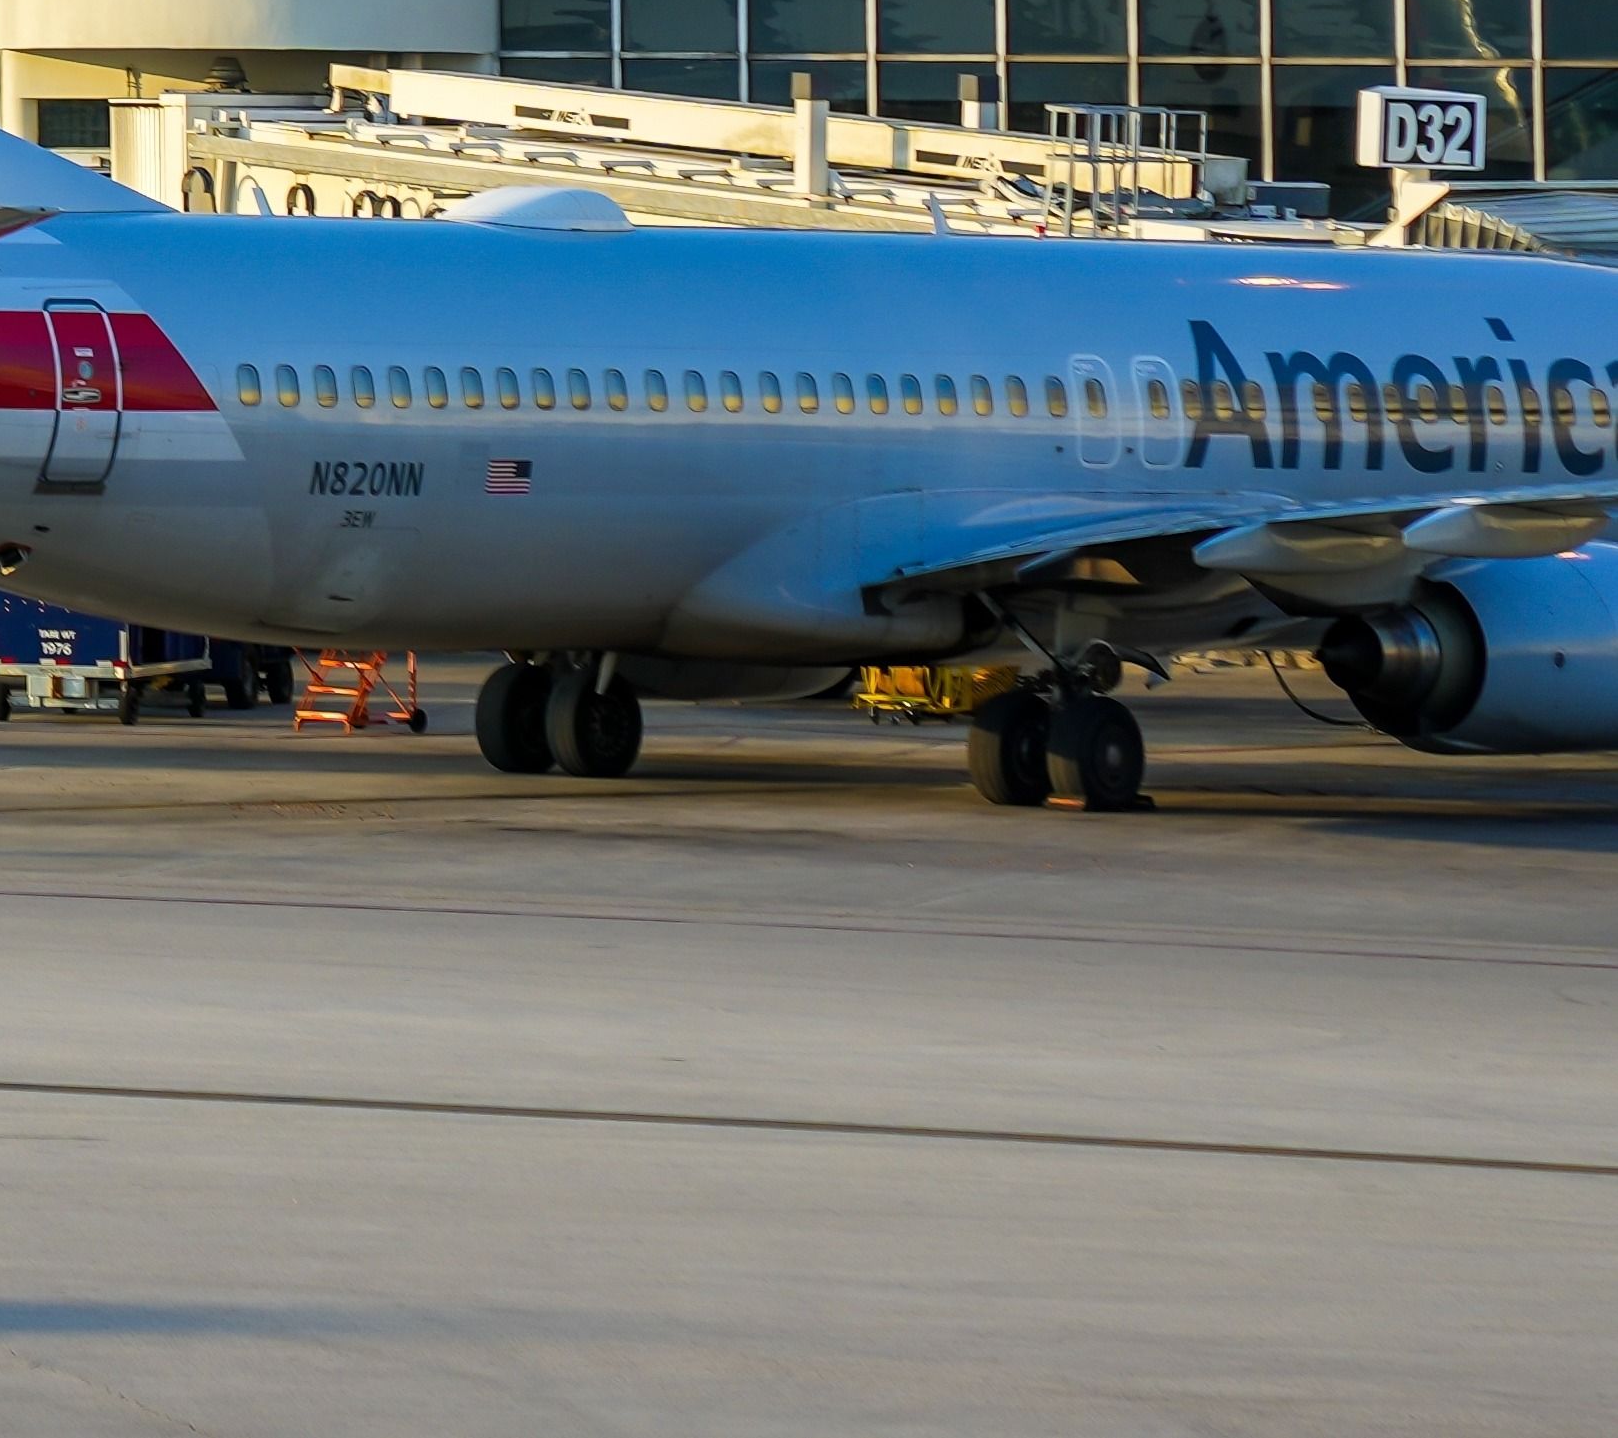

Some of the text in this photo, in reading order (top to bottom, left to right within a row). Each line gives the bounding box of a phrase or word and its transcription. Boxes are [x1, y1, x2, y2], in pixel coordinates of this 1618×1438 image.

[1385, 101, 1473, 165] D32
[1183, 317, 1618, 477] Americ
[309, 460, 425, 497] N820NN
[340, 509, 377, 528] 3EW
